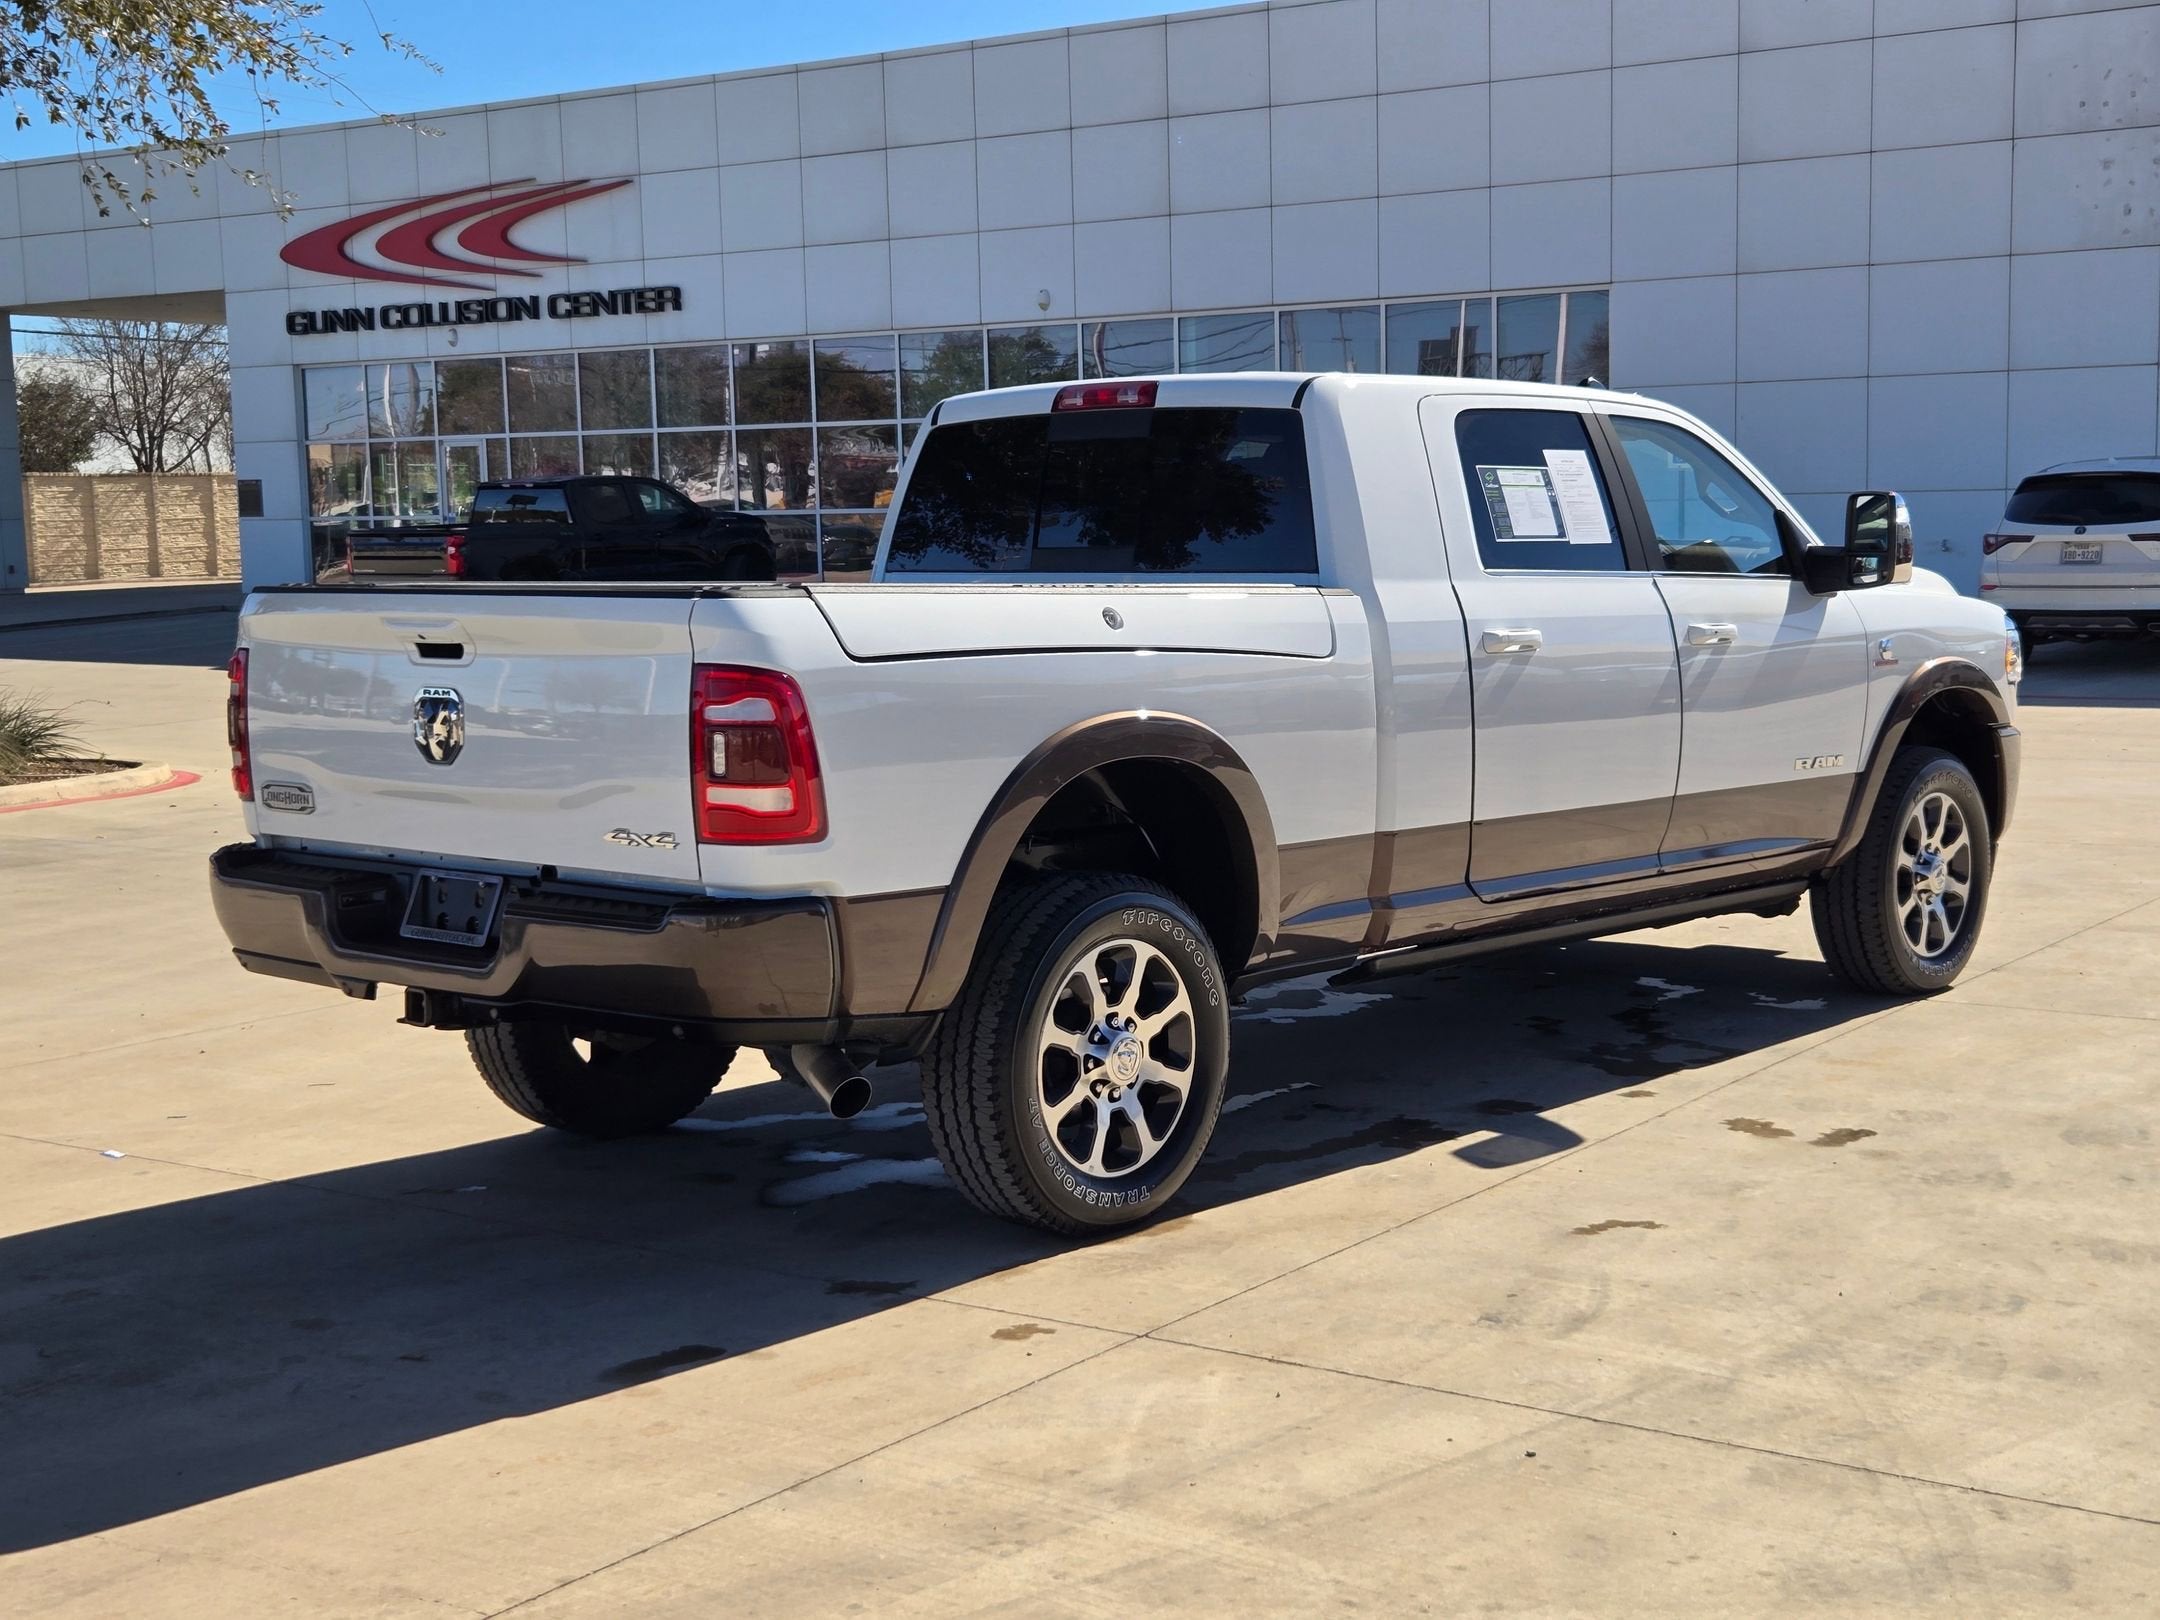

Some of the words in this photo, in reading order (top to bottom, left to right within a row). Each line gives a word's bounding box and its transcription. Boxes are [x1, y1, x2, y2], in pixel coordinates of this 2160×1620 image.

[286, 307, 376, 336] GUNN
[380, 296, 541, 330] COLLISION
[547, 286, 683, 320] CENTER
[423, 689, 451, 697] RAM
[1794, 754, 1844, 771] RAM
[1028, 1097, 1044, 1129] AT
[1037, 1139, 1151, 1208] TRANSFORCE
